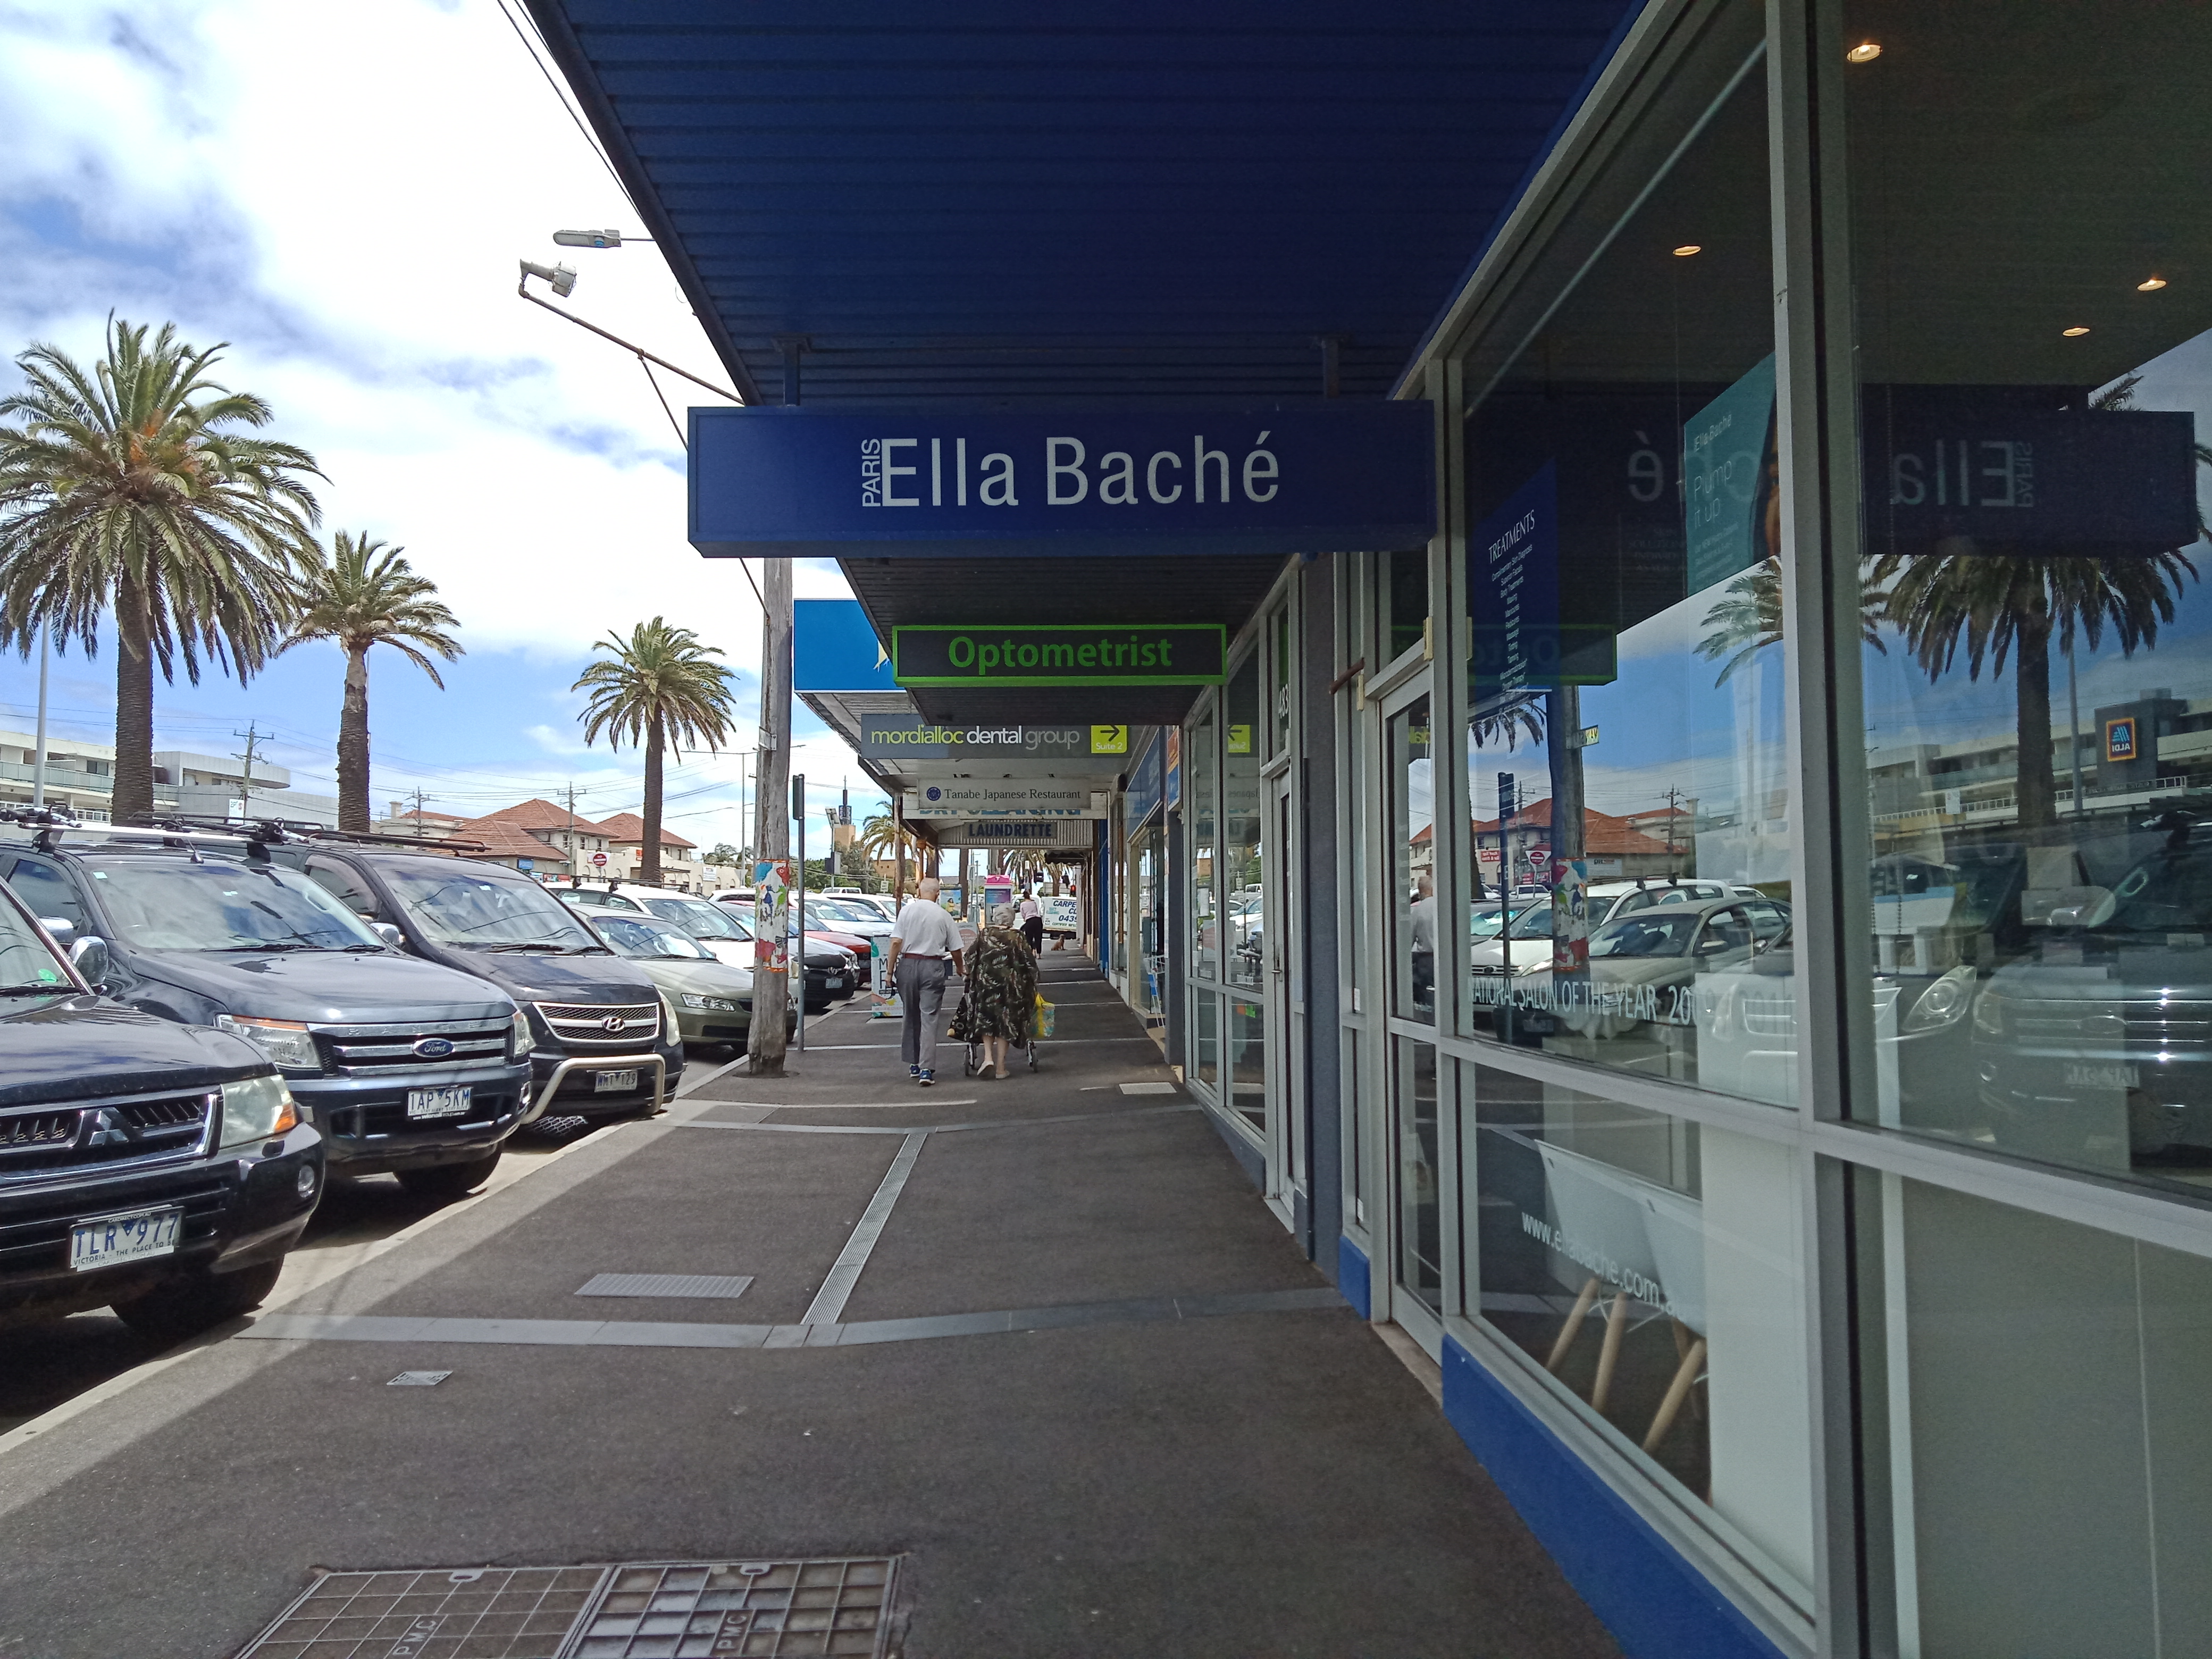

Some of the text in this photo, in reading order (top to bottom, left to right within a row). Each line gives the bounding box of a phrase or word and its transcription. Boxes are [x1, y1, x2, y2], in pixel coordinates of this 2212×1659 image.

[861, 438, 881, 507] PARIS
[881, 430, 1279, 507] Ella Baché
[1488, 509, 1536, 564] TREATMENTS
[948, 635, 1172, 676] Optometrist
[870, 724, 1080, 750] mordialloc dental group
[944, 789, 1081, 801] Tanabe Japanese Restaurant
[969, 823, 1052, 837] LAUNDRETTE
[1518, 979, 1557, 1010] SALON
[1562, 981, 1579, 1013] OF
[1582, 982, 1610, 1016] THE
[1613, 983, 1659, 1022] YEAR
[424, 1041, 447, 1053] Ford
[410, 1089, 470, 1110] 1AP 5KM
[74, 1213, 179, 1258] TLR 977
[73, 1254, 105, 1266] VICTORIA
[132, 1243, 152, 1253] PLACE
